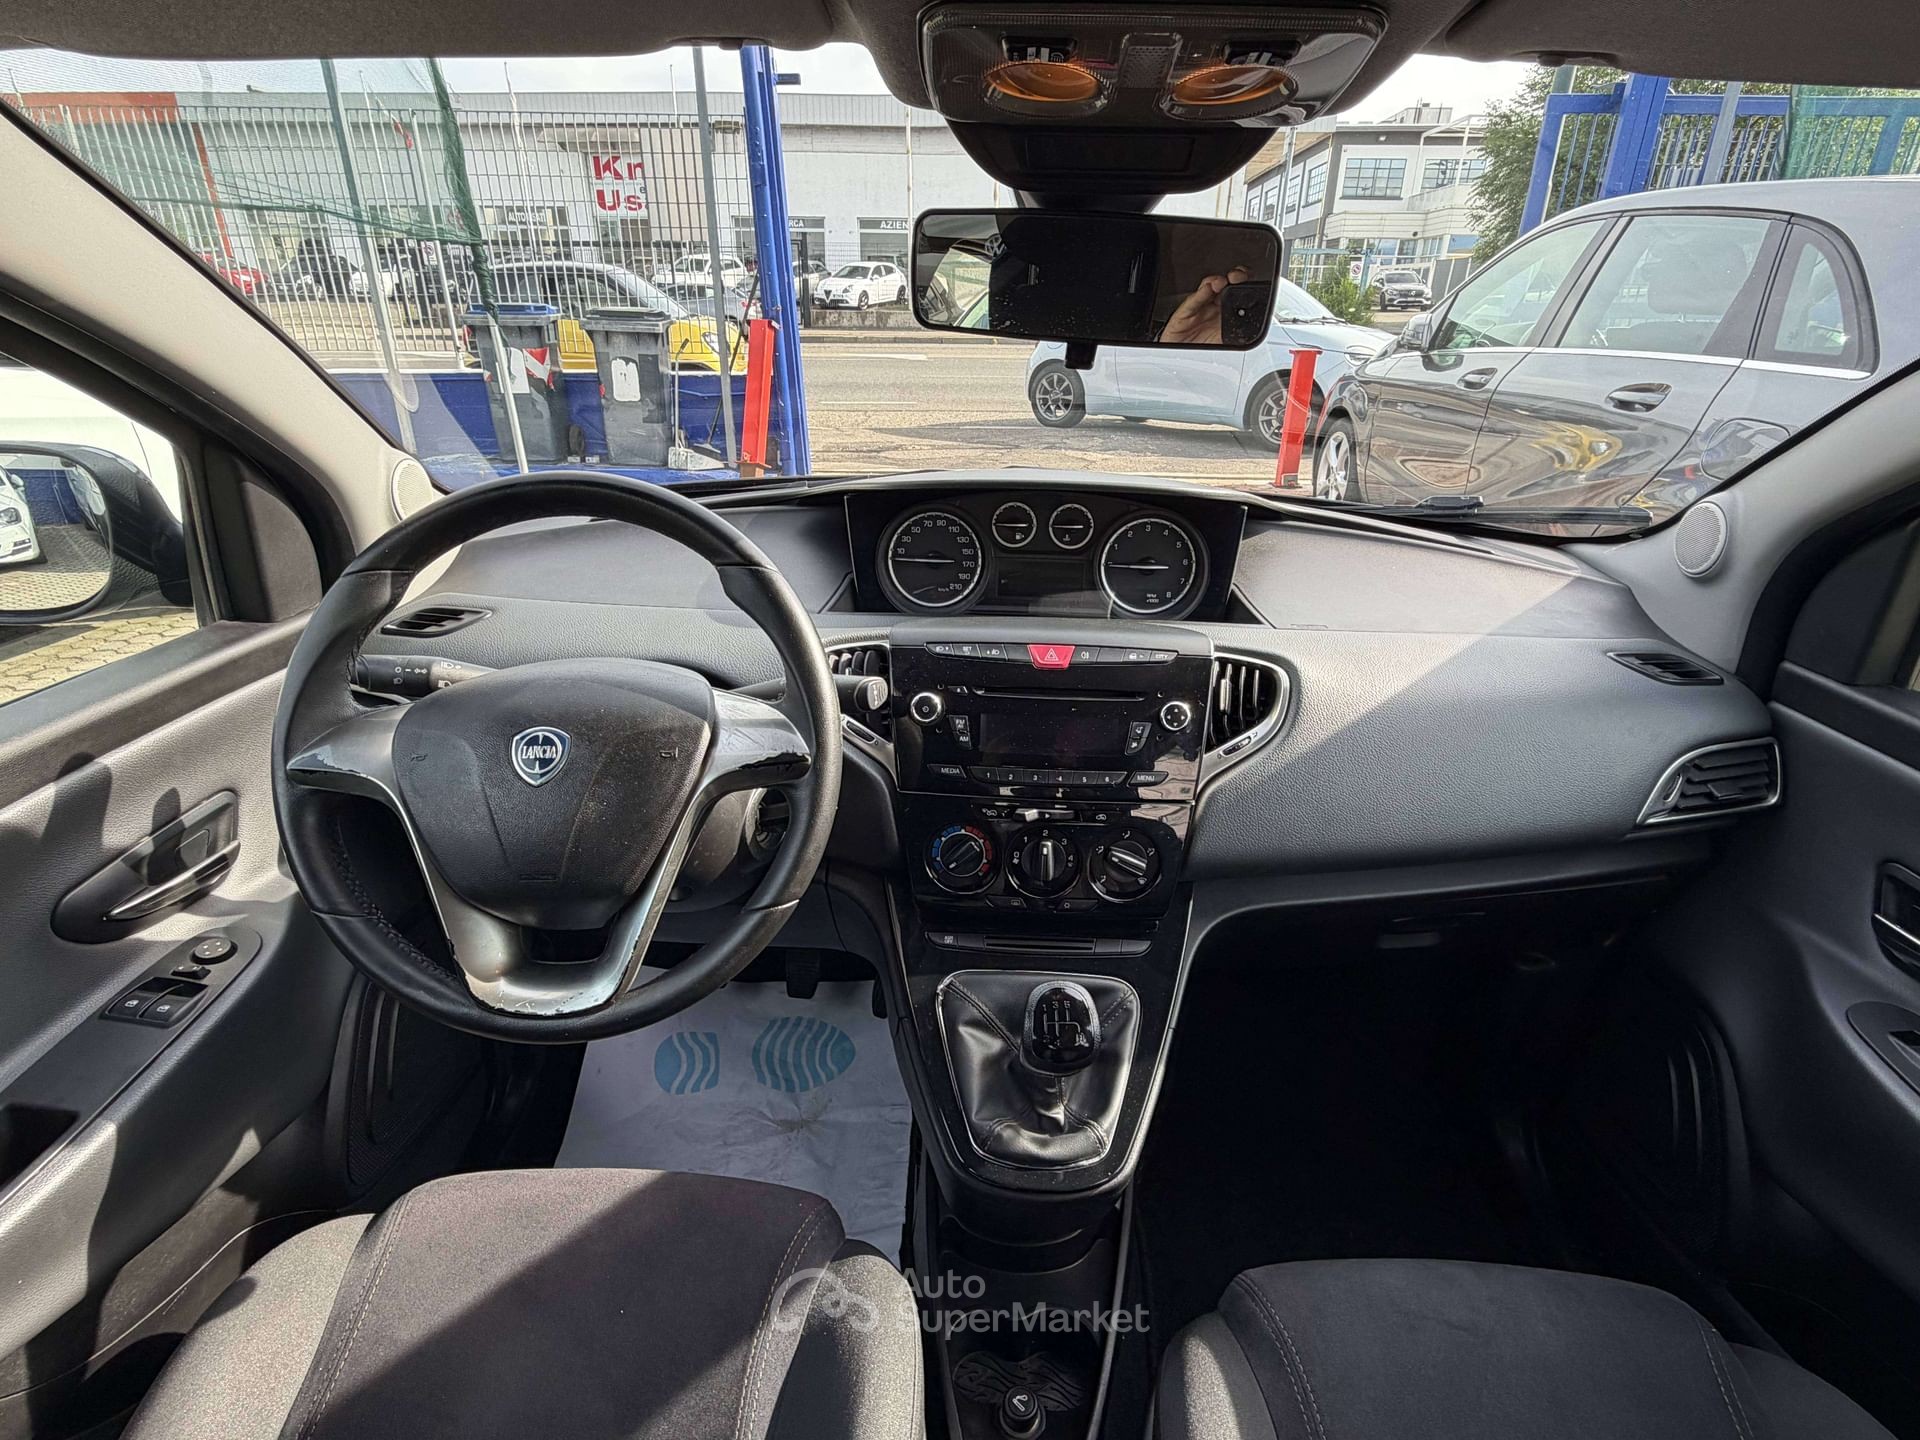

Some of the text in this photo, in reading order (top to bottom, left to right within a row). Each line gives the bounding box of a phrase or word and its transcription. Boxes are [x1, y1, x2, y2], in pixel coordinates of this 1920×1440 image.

[923, 519, 947, 528] 70 90
[911, 526, 921, 534] 50
[1176, 541, 1182, 549] 5
[896, 547, 905, 555] 10
[521, 745, 556, 759] LANCIA
[1042, 829, 1048, 837] 2
[1052, 1001, 1059, 1009] 3
[1063, 1000, 1070, 1008] 5
